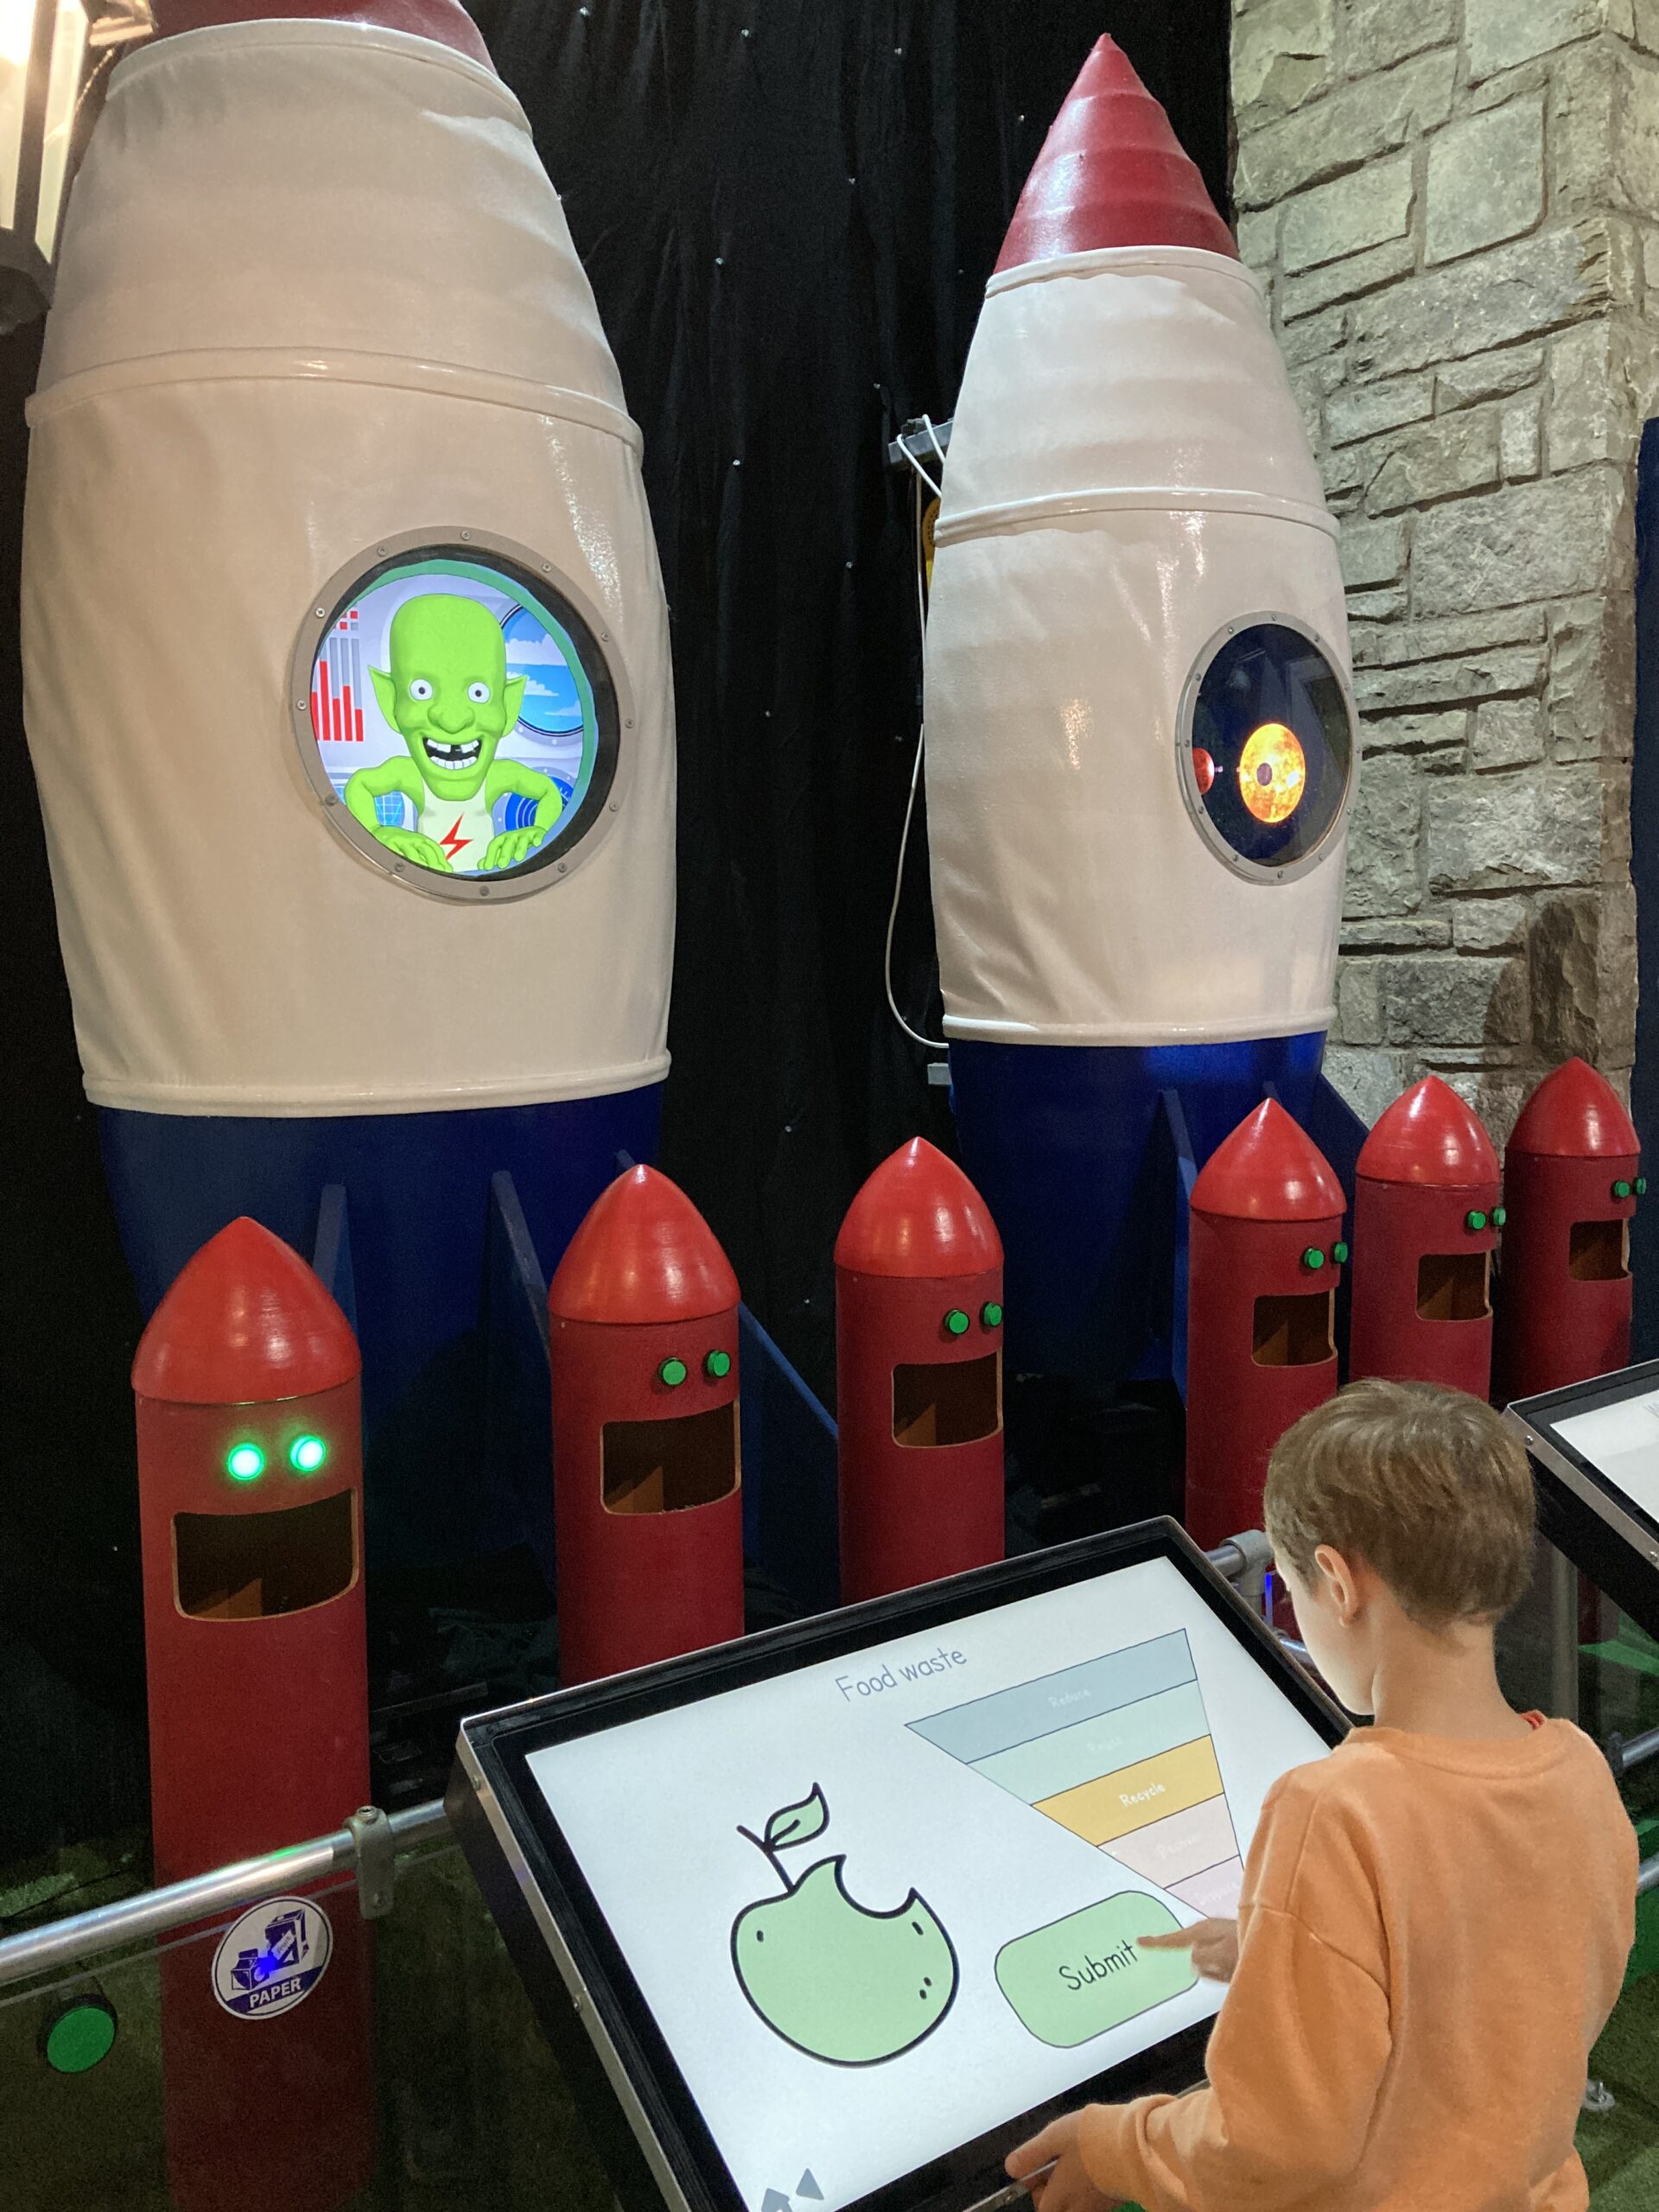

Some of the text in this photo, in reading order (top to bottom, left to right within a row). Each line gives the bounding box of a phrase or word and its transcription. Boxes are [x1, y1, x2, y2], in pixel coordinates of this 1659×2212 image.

[835, 1647, 967, 1702] Food waste
[1119, 1782, 1166, 1808] Recycle
[1058, 1939, 1138, 1991] Submit
[250, 1977, 302, 2008] PAPER
